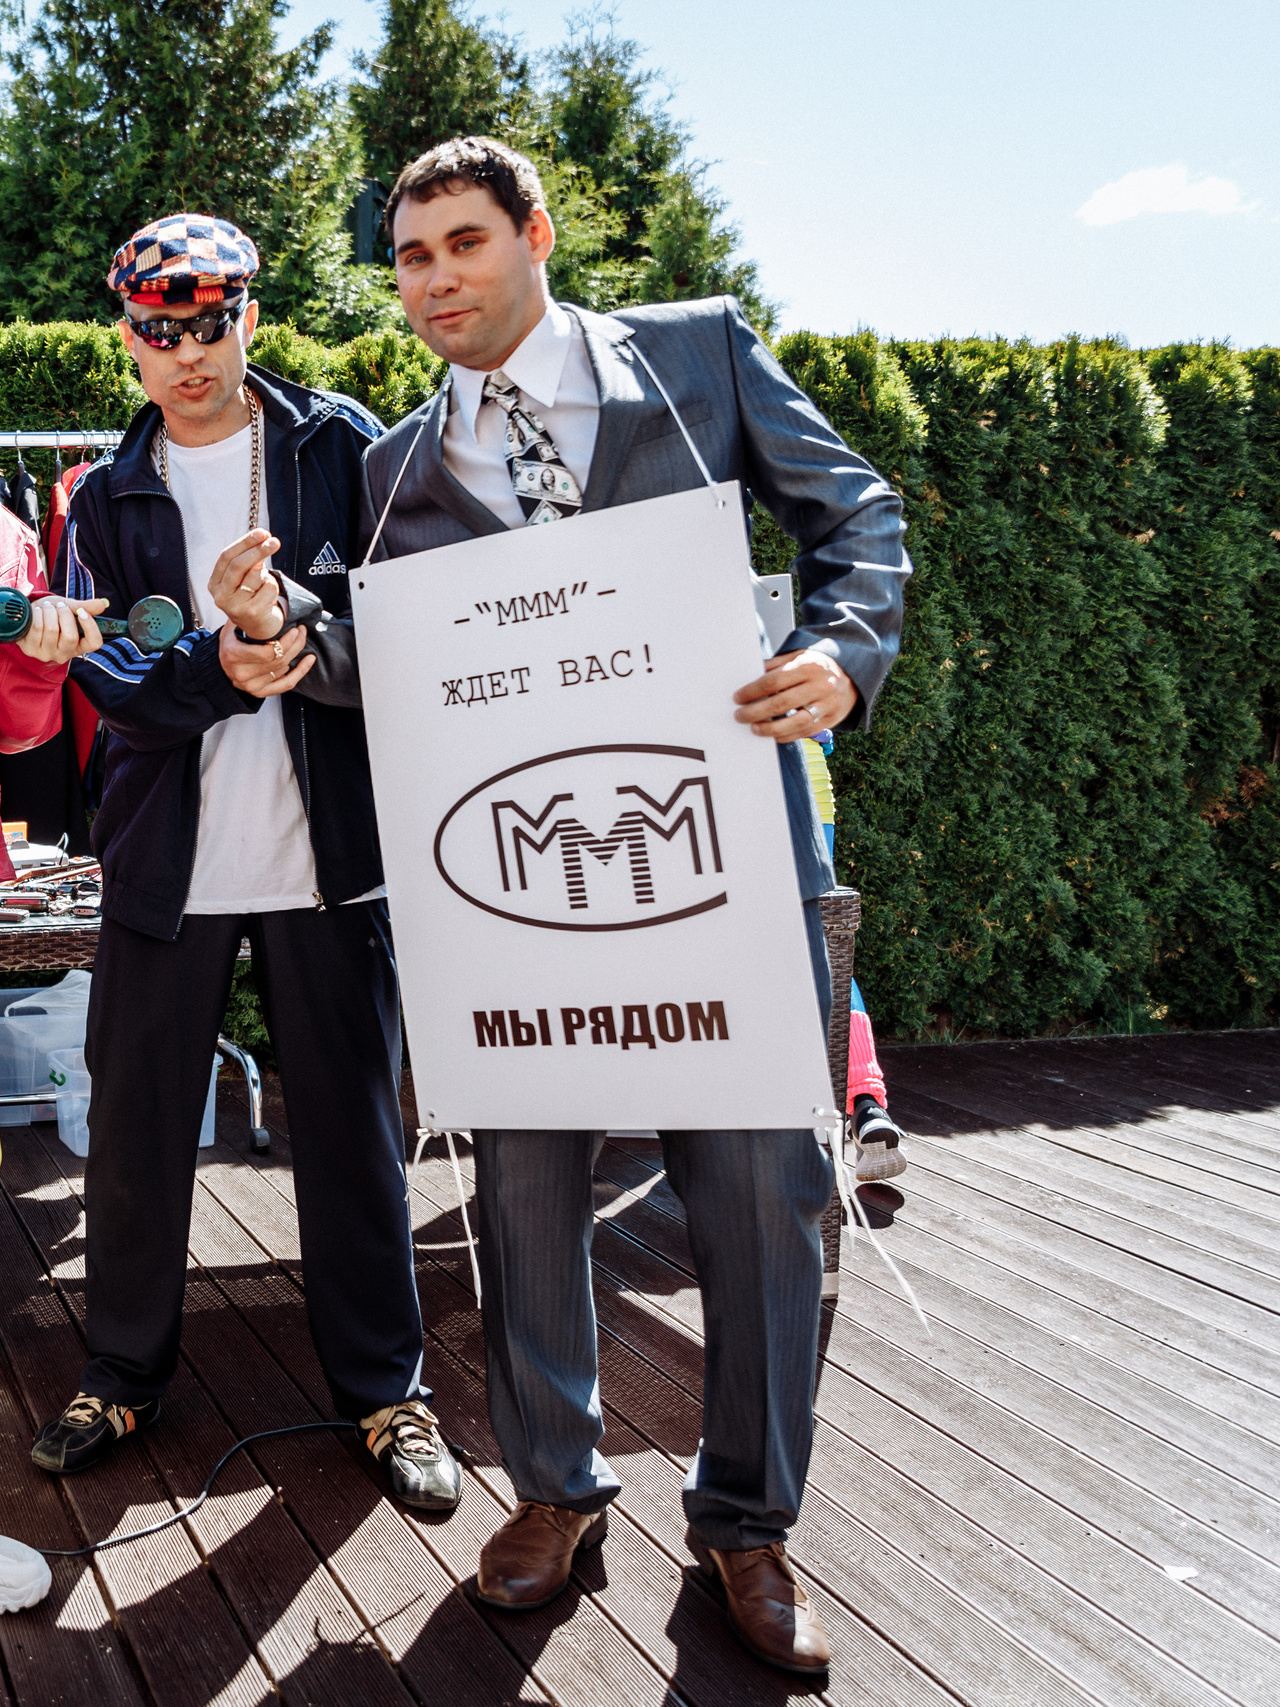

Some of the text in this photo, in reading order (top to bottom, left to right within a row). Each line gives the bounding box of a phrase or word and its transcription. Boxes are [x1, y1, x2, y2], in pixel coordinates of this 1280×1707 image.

[308, 564, 347, 576] adidas
[441, 643, 654, 708] ЖДЕТ ВАС!
[491, 776, 724, 909] МММ
[472, 1000, 730, 1051] МЫ РЯДОМ
